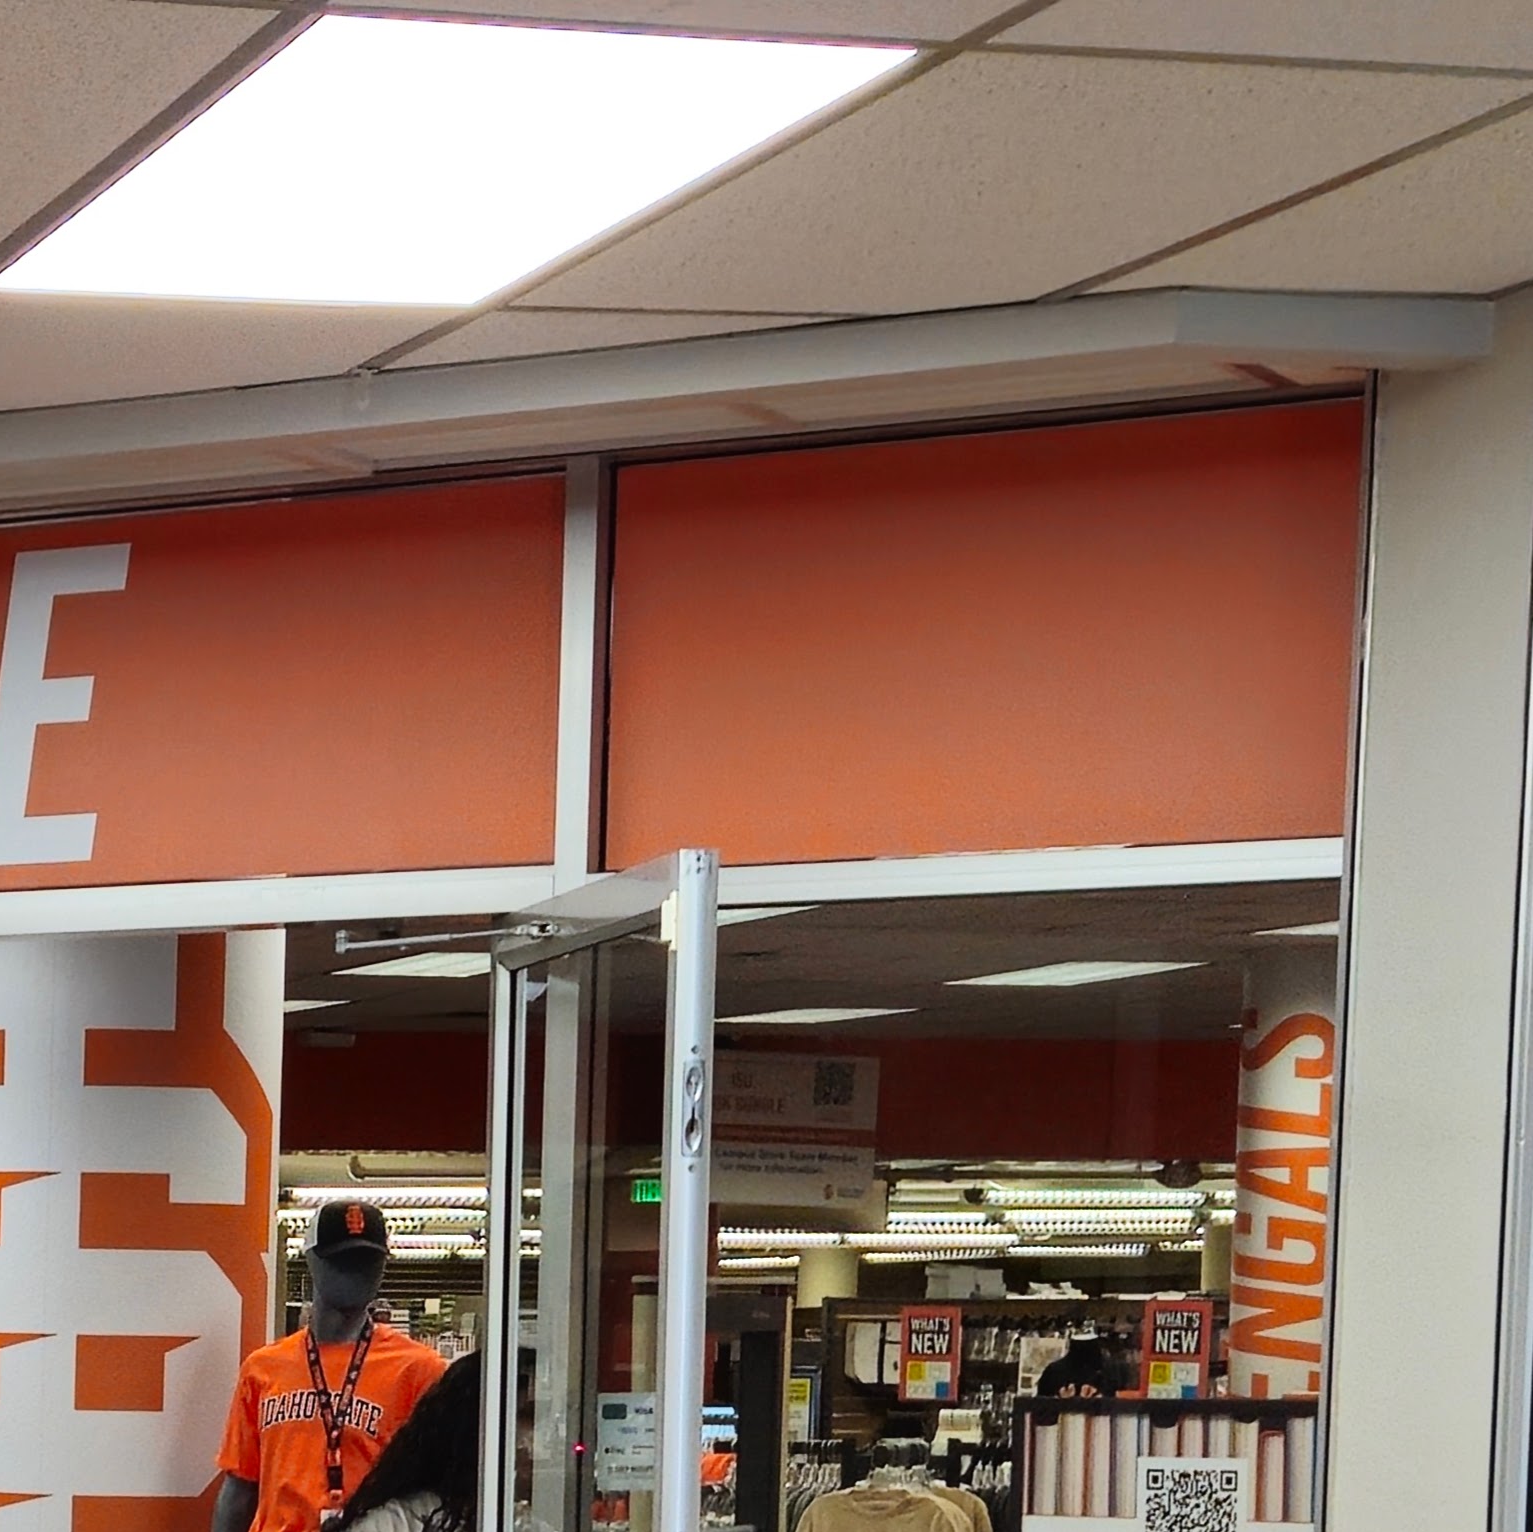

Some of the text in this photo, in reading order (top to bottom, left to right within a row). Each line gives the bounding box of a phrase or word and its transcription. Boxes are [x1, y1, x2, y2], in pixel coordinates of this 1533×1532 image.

[910, 1316, 951, 1333] WHAT'S
[1155, 1310, 1200, 1328] WHAT'S
[911, 1333, 950, 1355] NEW
[1155, 1329, 1199, 1354] NEW
[260, 1390, 320, 1431] IDAHO
